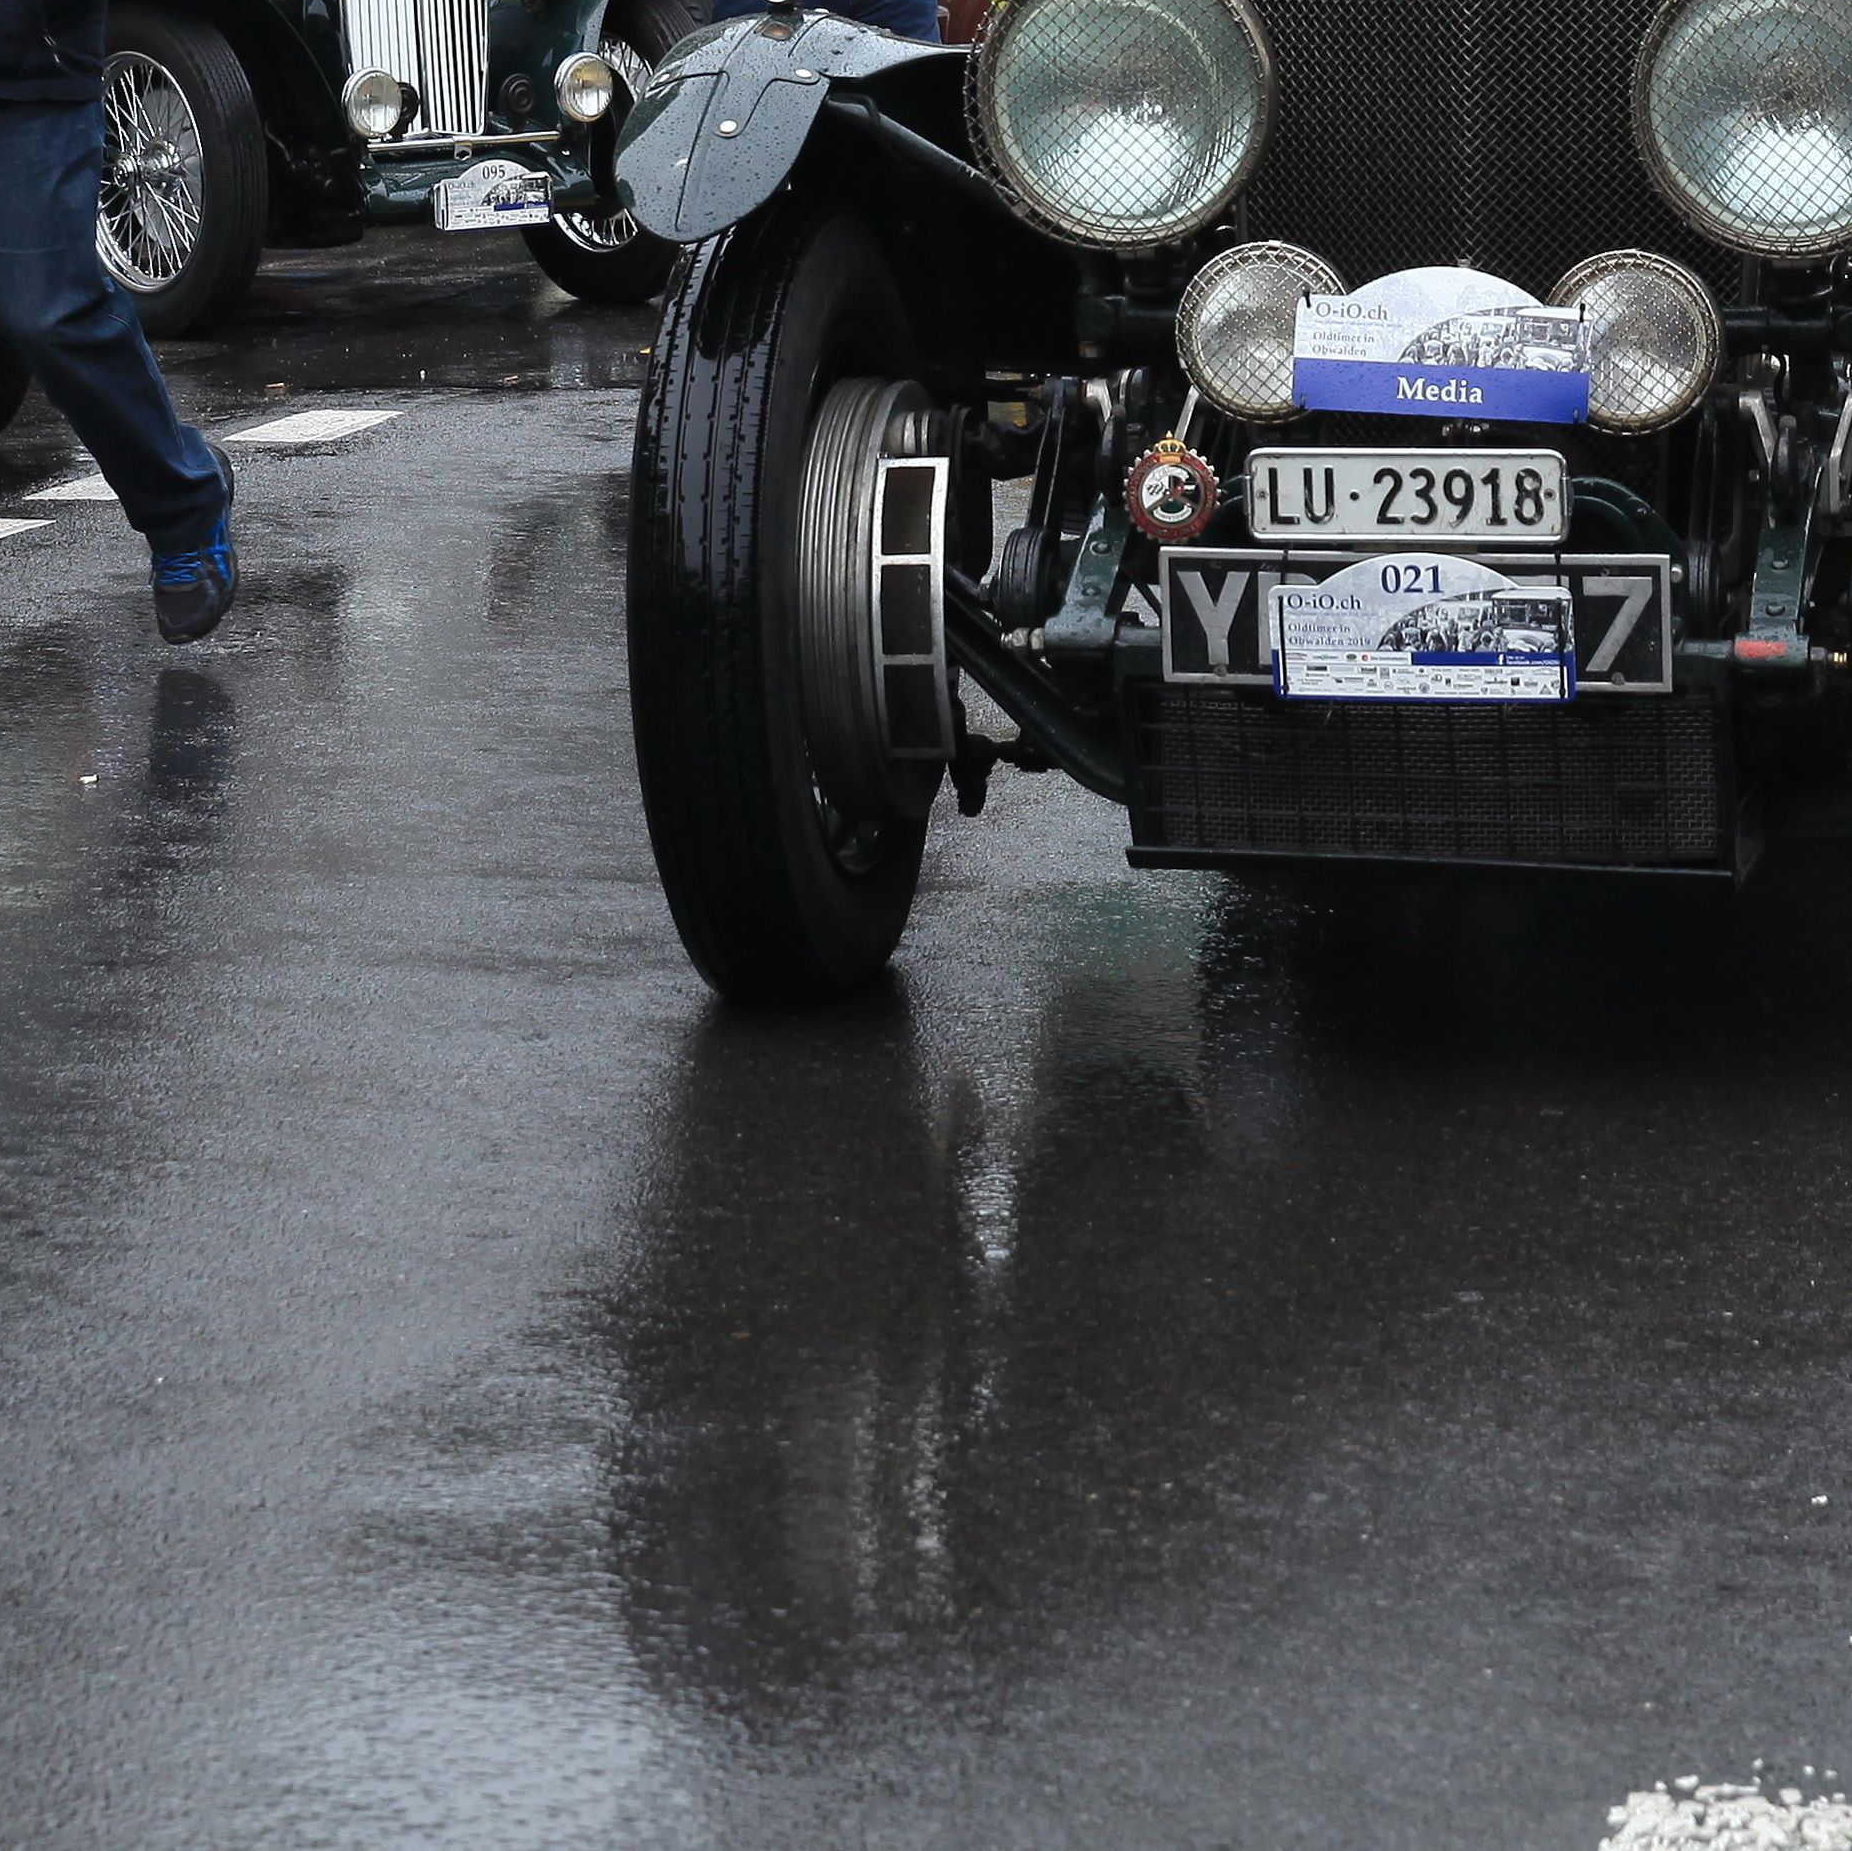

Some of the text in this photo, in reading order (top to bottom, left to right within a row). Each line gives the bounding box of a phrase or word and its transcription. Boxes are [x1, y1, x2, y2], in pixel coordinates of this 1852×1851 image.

[482, 164, 506, 180] 095
[1315, 301, 1388, 321] O-iO.ch
[1312, 331, 1375, 344] Oldtimer in
[1312, 343, 1368, 357] Obwalden
[1396, 376, 1484, 405] Media
[1372, 466, 1547, 527] 23918
[1380, 564, 1444, 595] 021
[1287, 594, 1362, 610] O-iO.ch
[1288, 623, 1351, 633] Oldtimer in
[1288, 636, 1371, 647] Obwalden 2019
